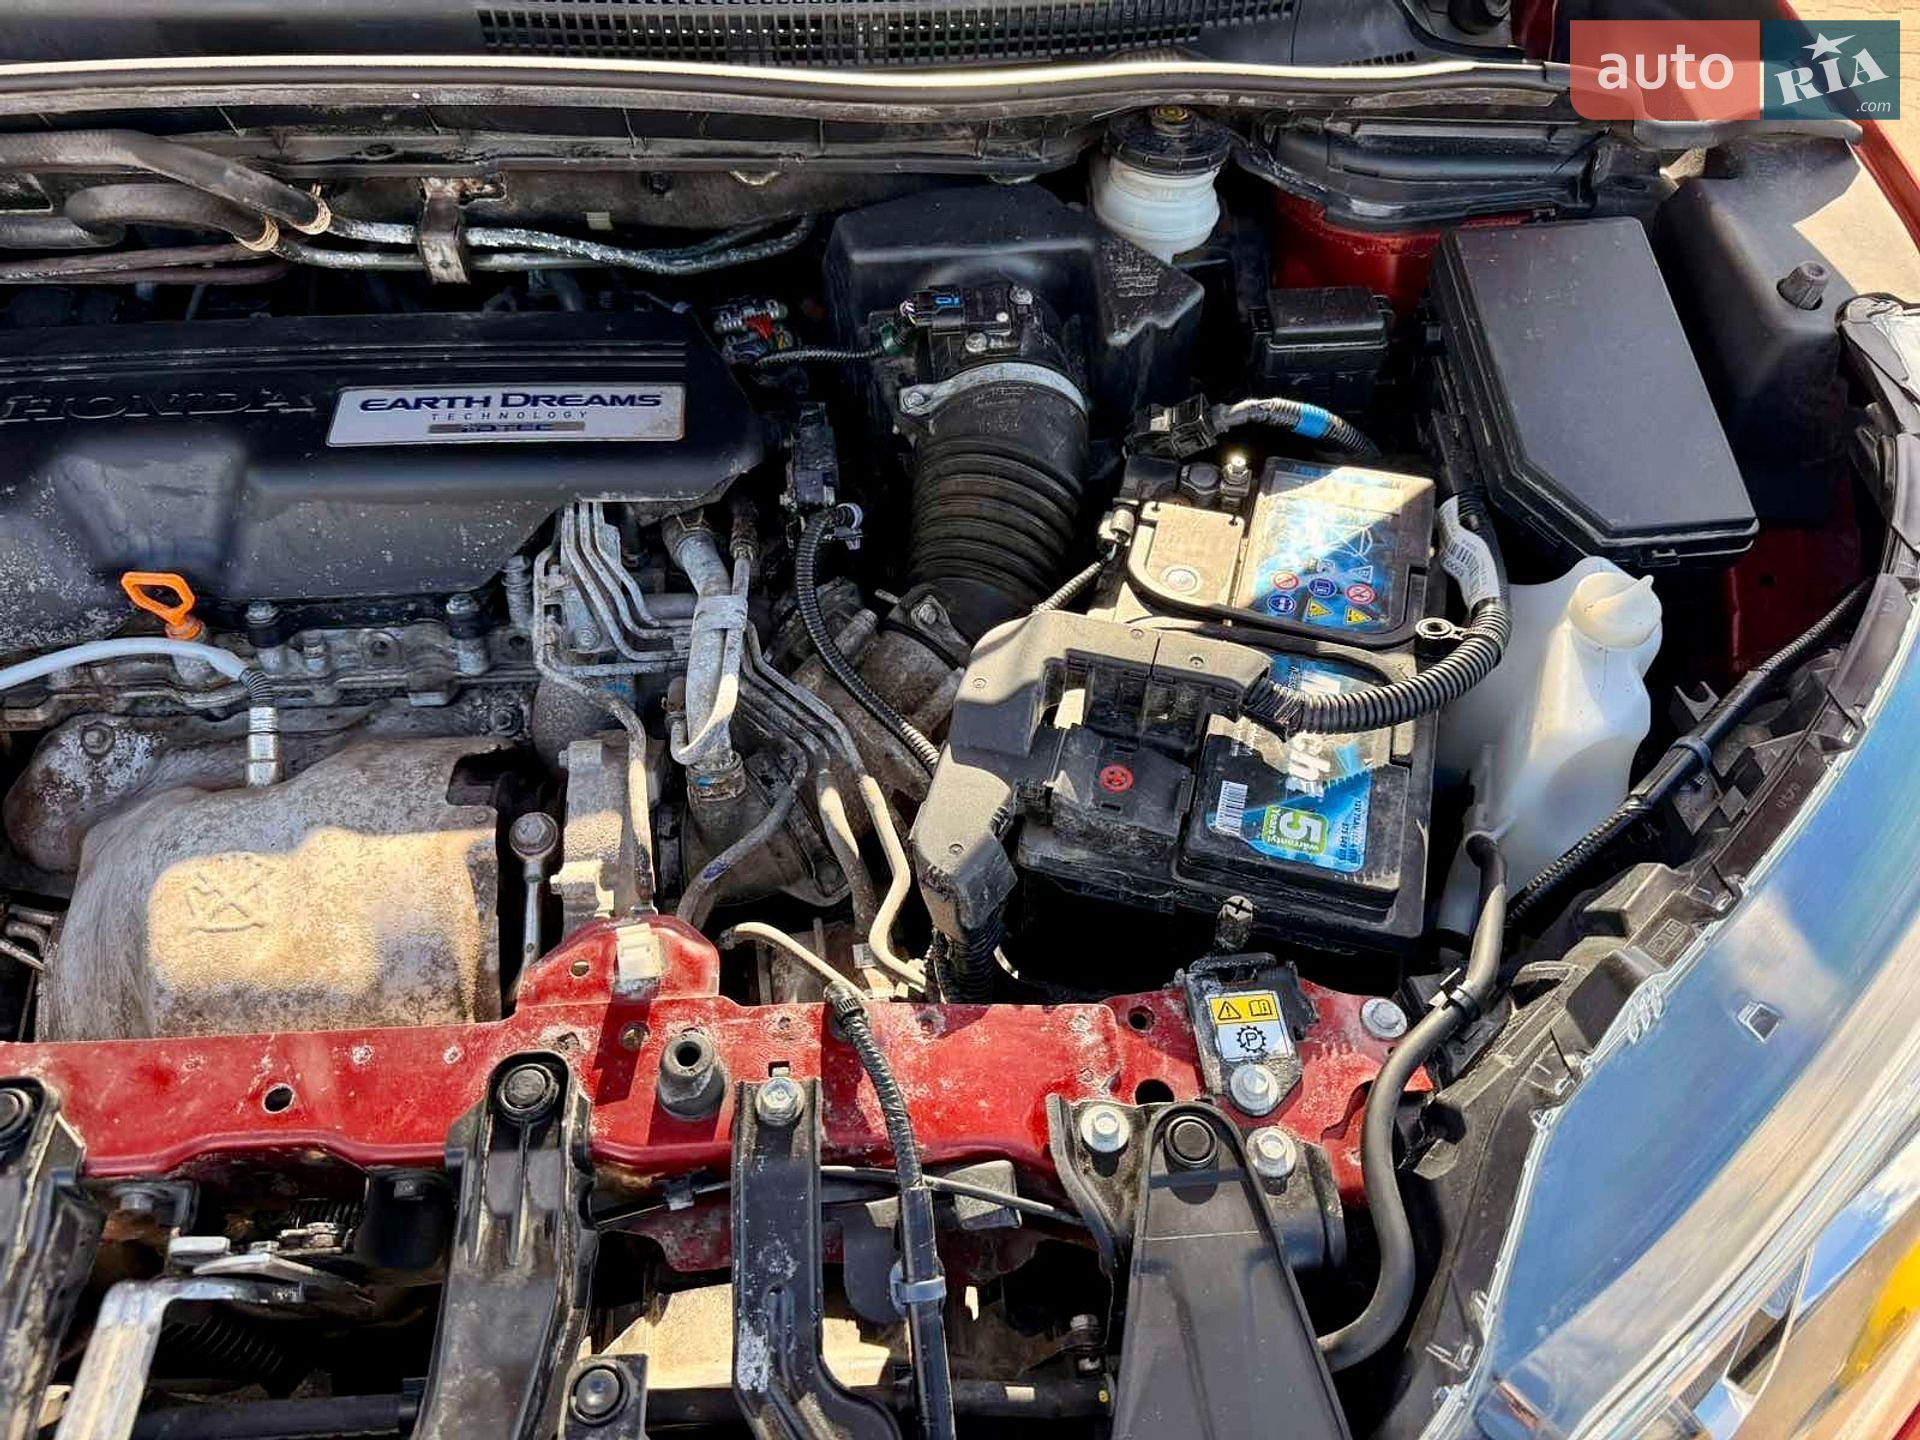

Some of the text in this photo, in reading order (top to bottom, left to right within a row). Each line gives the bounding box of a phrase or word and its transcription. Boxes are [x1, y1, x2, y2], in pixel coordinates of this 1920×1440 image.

[0, 389, 316, 423] HONDA
[360, 392, 661, 412] EARTH DREAMS
[431, 411, 587, 421] TECHNOLOGY
[1280, 811, 1323, 842] 5
